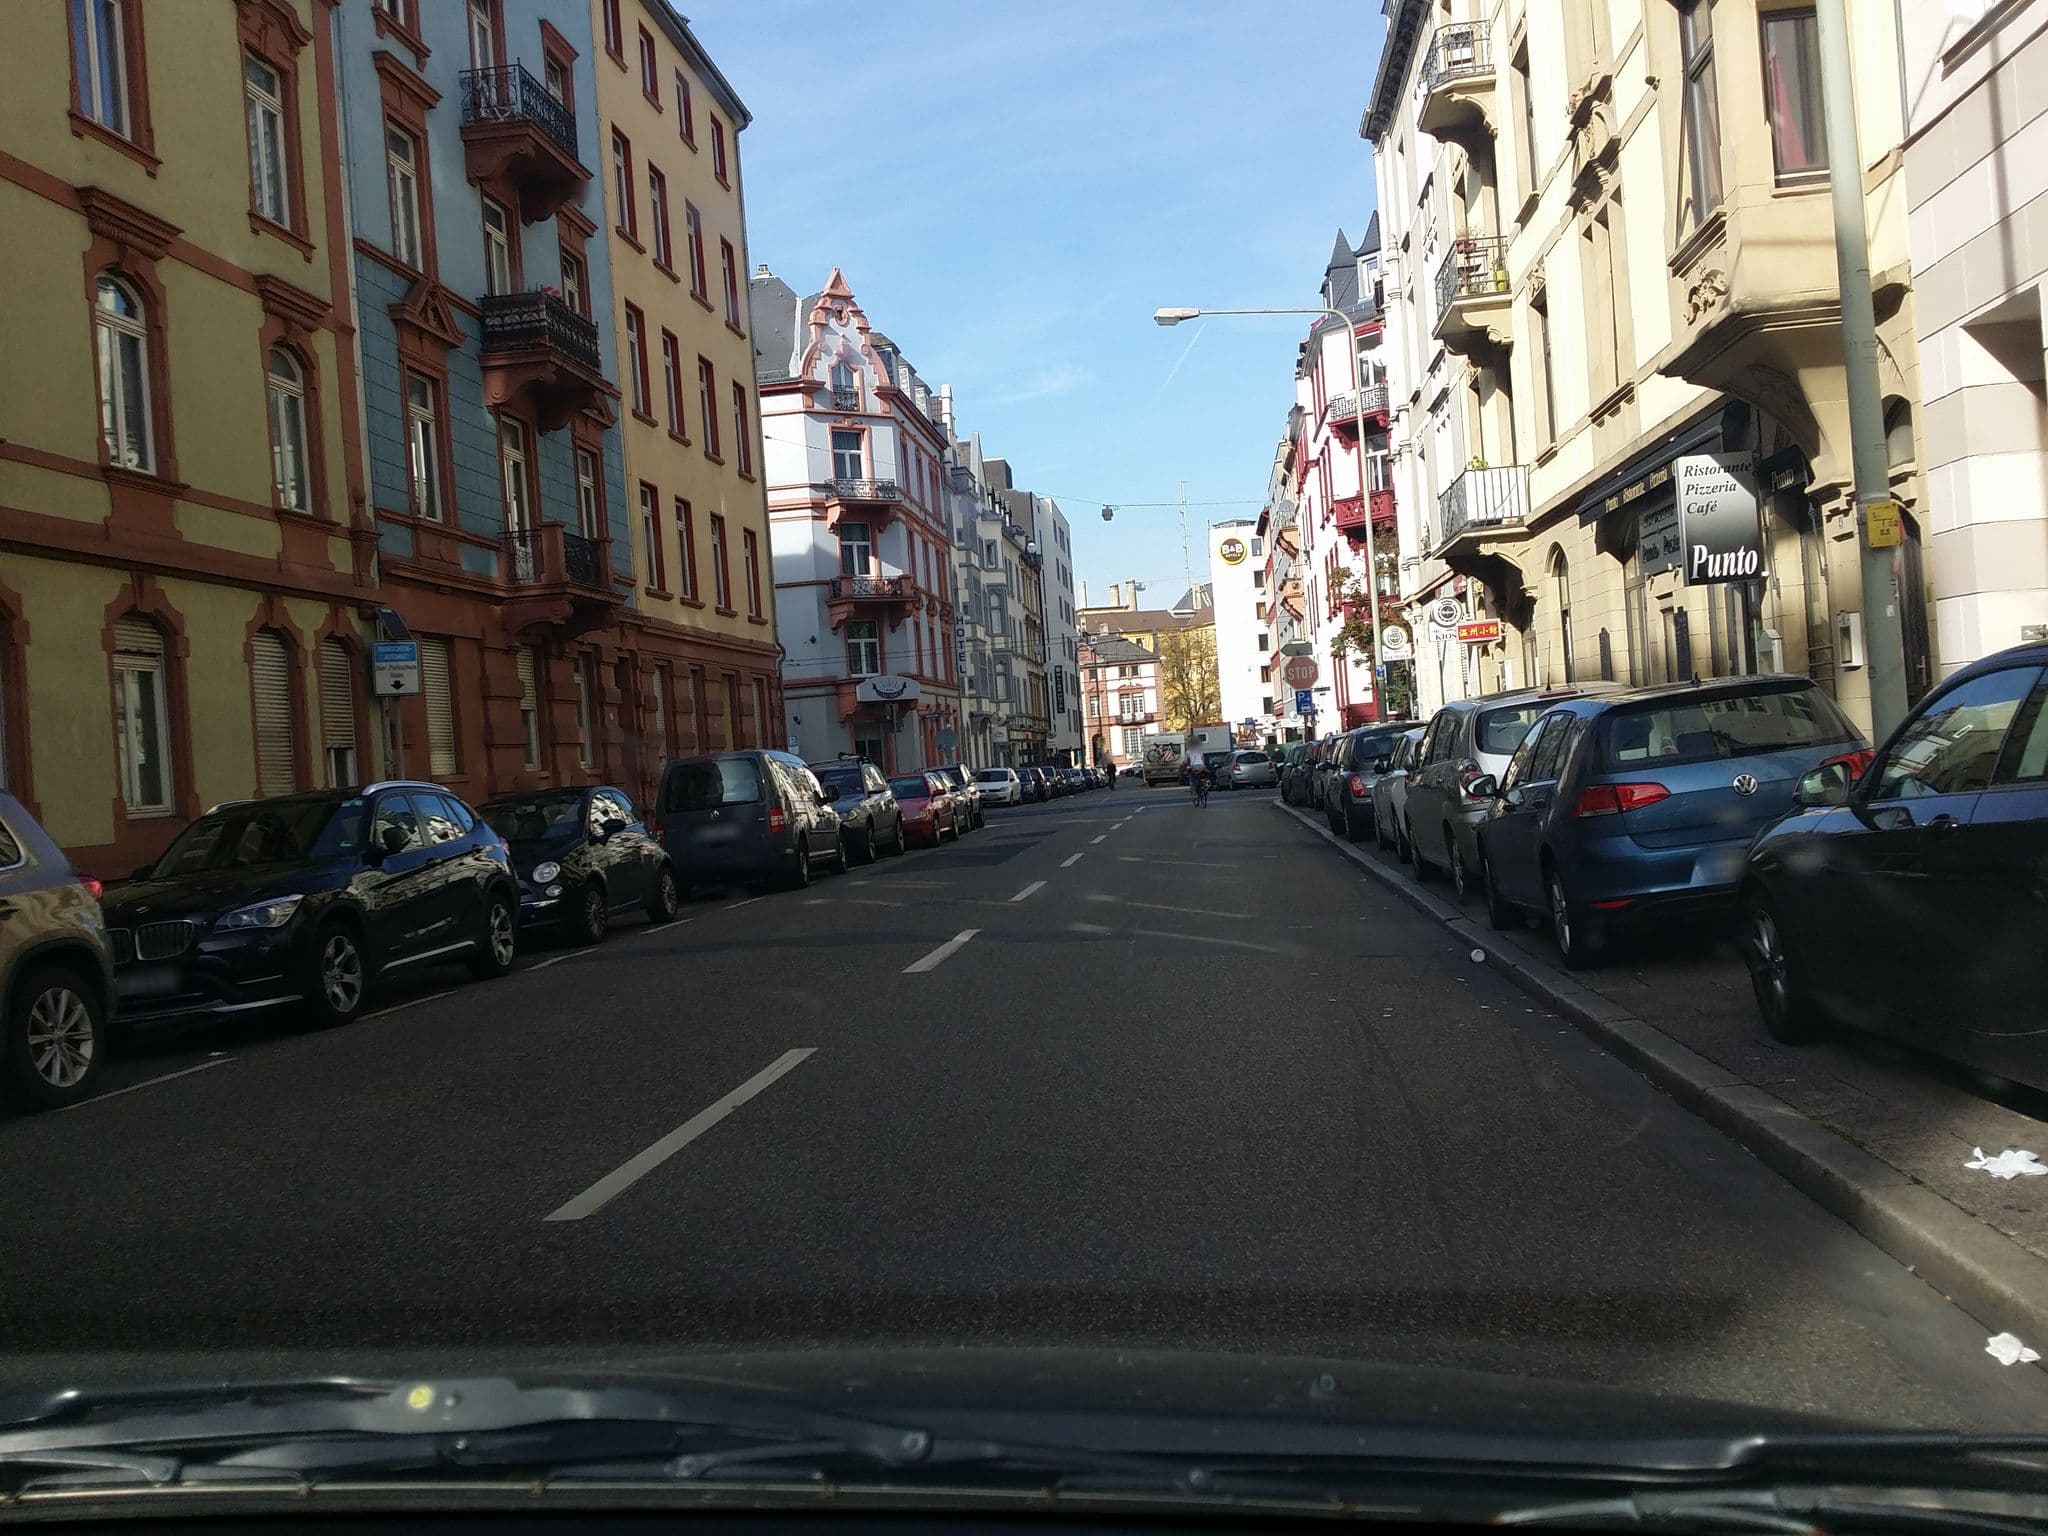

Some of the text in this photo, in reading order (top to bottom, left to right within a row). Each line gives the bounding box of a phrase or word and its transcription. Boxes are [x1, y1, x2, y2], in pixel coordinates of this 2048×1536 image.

[1684, 462, 1752, 477] Ristorante
[1771, 469, 1795, 492] Punto
[1685, 481, 1737, 496] Pizzeria
[1687, 500, 1718, 516] Café
[1222, 544, 1243, 554] B&B
[1690, 544, 1758, 579] Punto
[1435, 632, 1457, 641] KIOS
[956, 616, 966, 673] HOTEL
[1288, 665, 1315, 680] STOP
[1298, 692, 1305, 702] P
[789, 736, 797, 745] P
